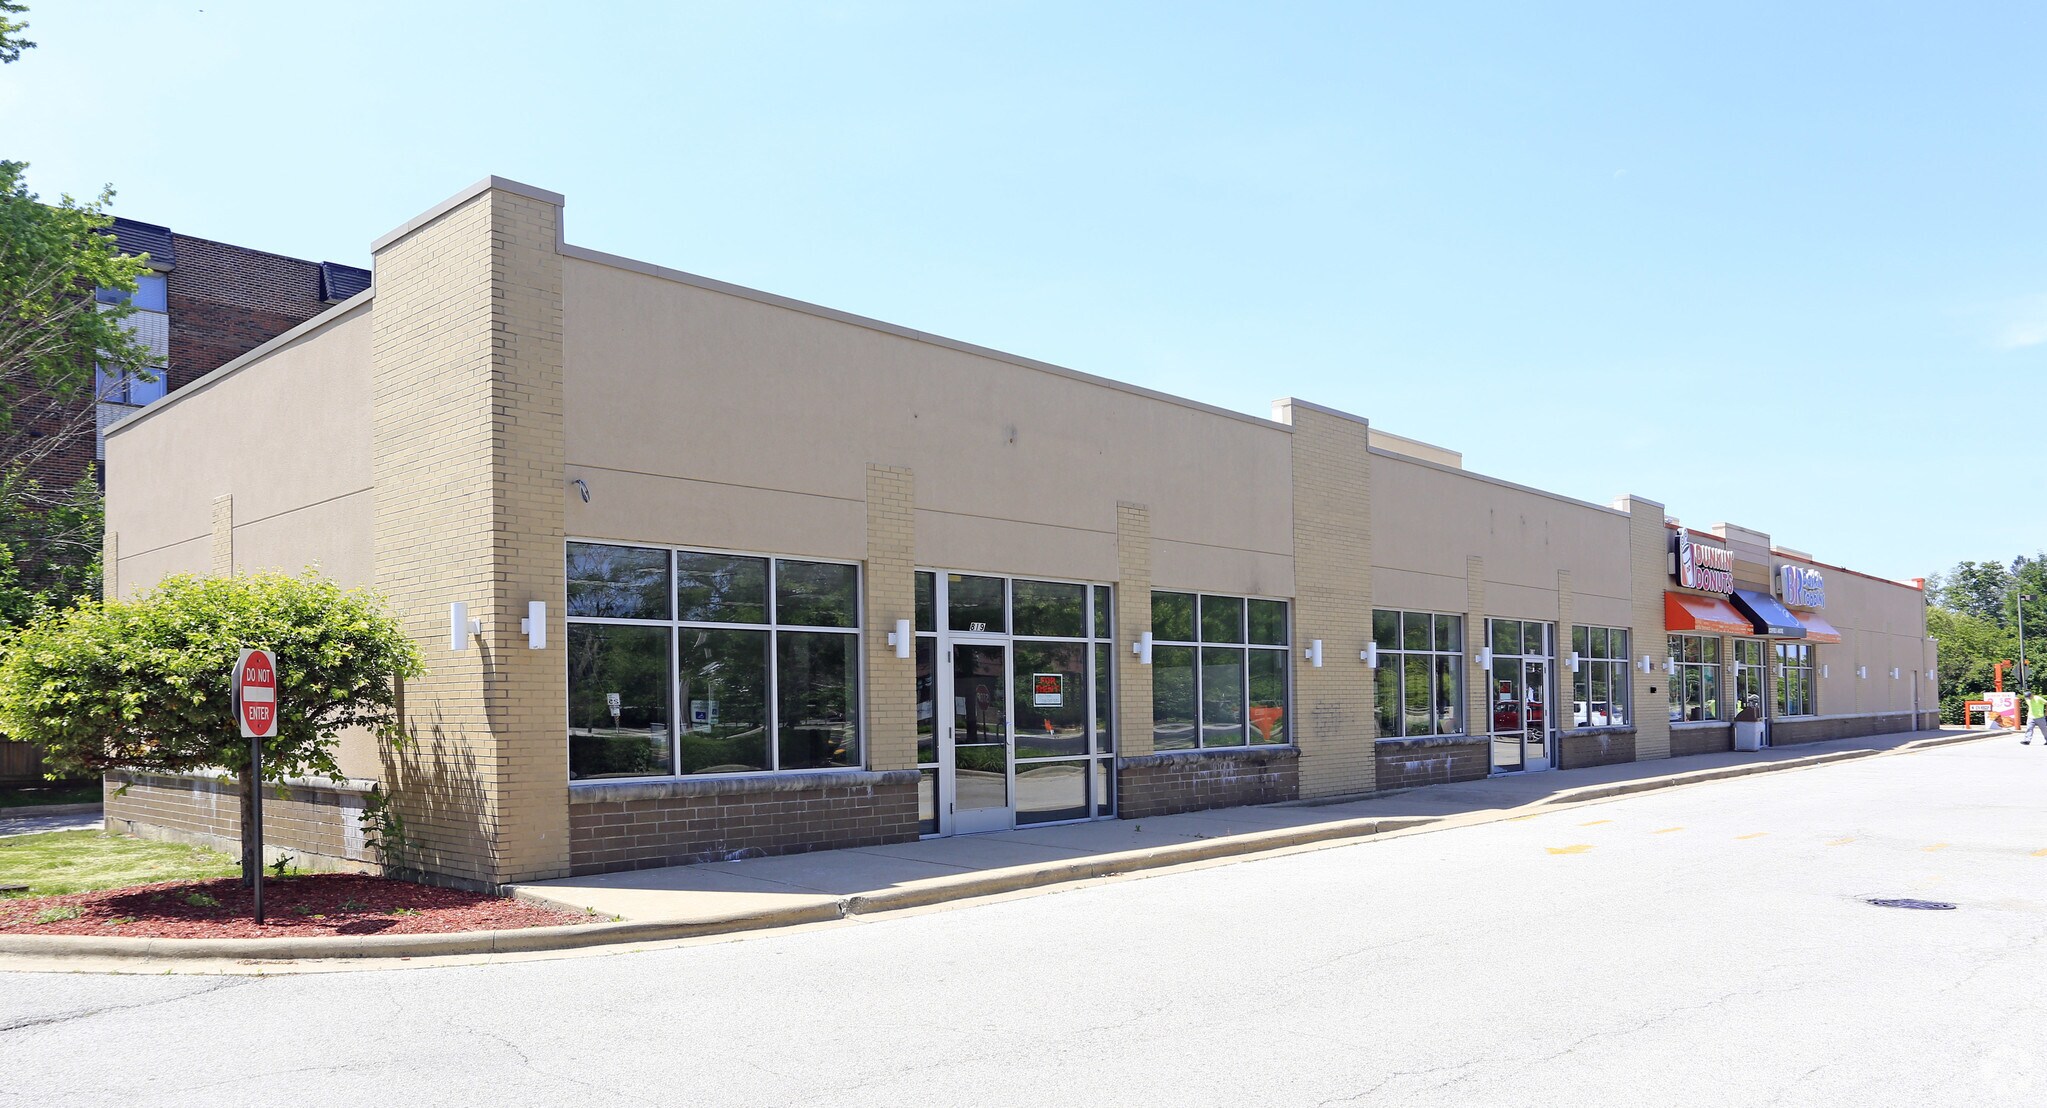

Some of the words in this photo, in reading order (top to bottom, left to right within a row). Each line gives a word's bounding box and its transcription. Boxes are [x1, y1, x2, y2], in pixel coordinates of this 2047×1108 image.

[1694, 543, 1734, 572] DUNKIN'
[1695, 567, 1733, 595] DONUTS
[970, 622, 985, 631] 819
[246, 667, 256, 682] DO
[257, 668, 271, 683] NOT
[248, 706, 270, 721] ENTER
